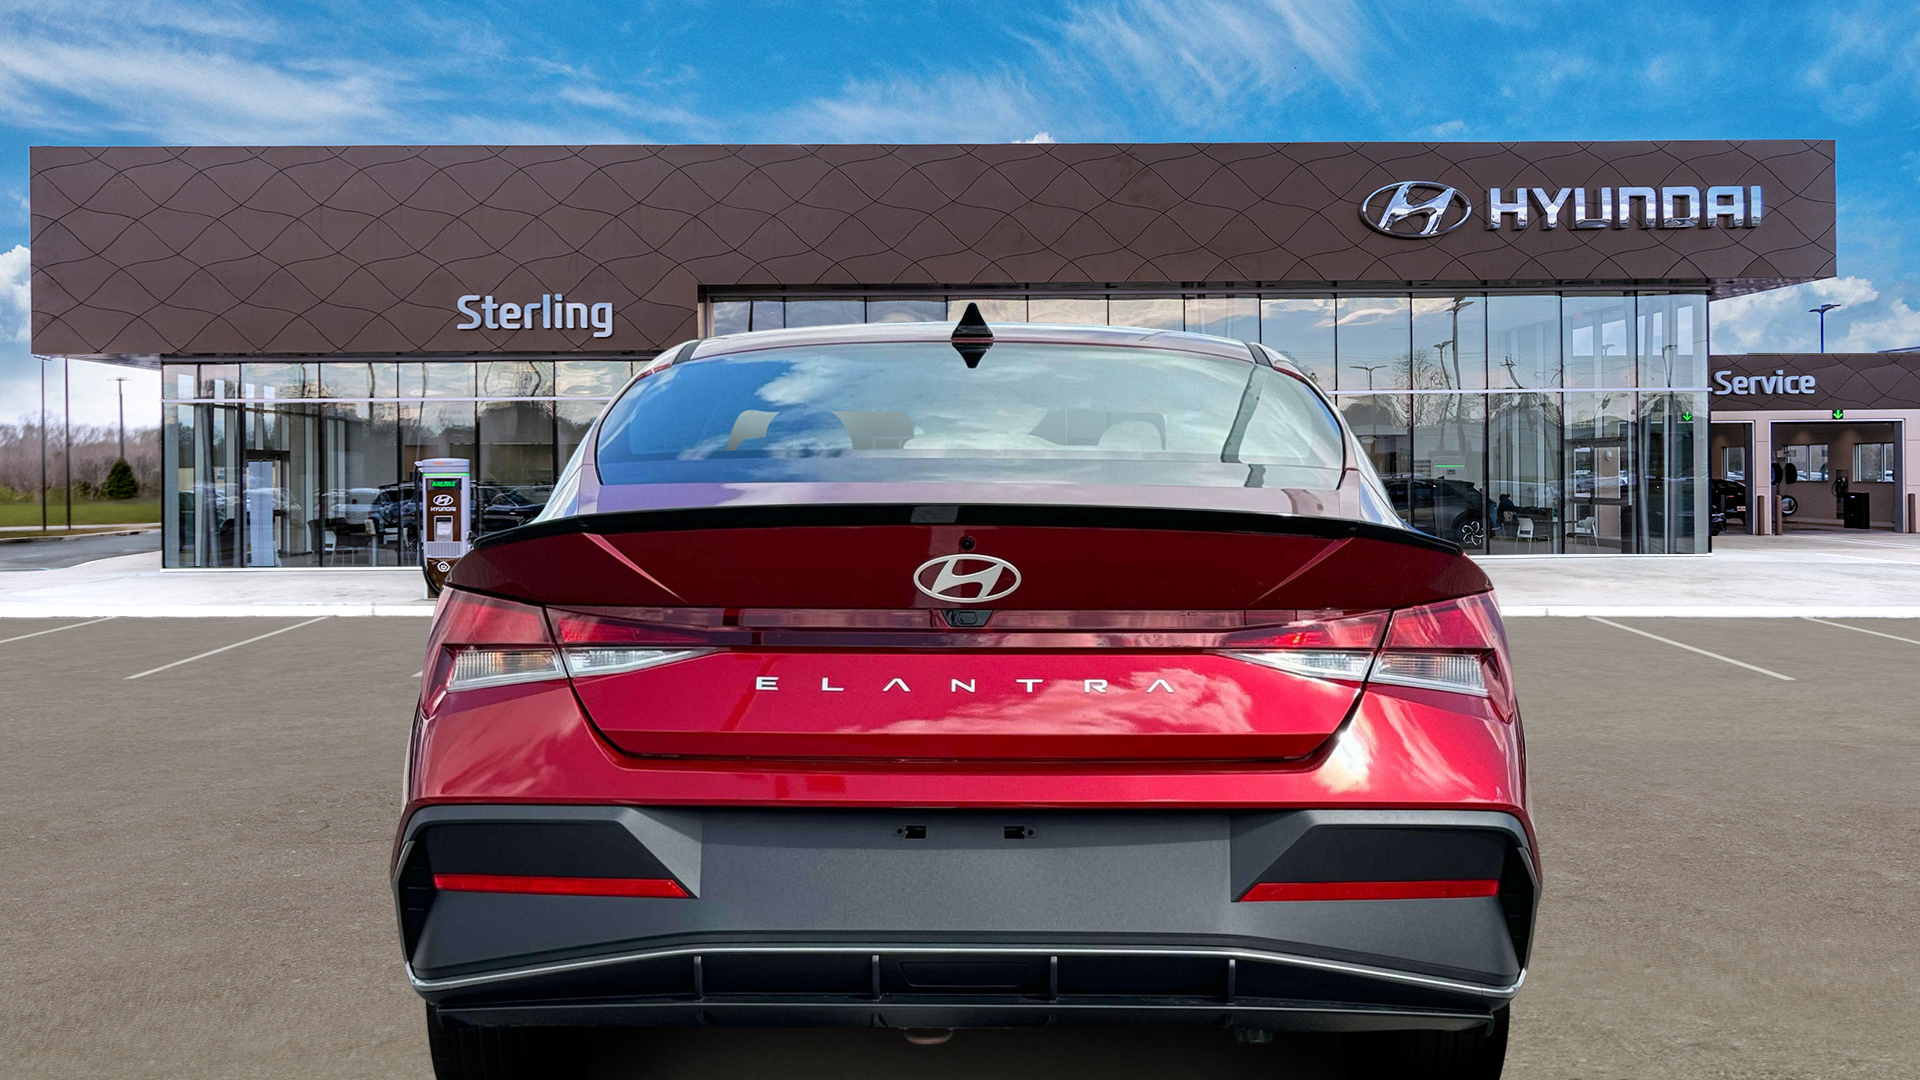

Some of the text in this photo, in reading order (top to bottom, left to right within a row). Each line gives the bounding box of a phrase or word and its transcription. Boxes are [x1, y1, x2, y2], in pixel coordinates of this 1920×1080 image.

[1487, 185, 1763, 231] HYUNDAI
[456, 293, 614, 339] Sterling
[1713, 369, 1817, 396] Service
[755, 675, 1175, 694] ELANTRA
